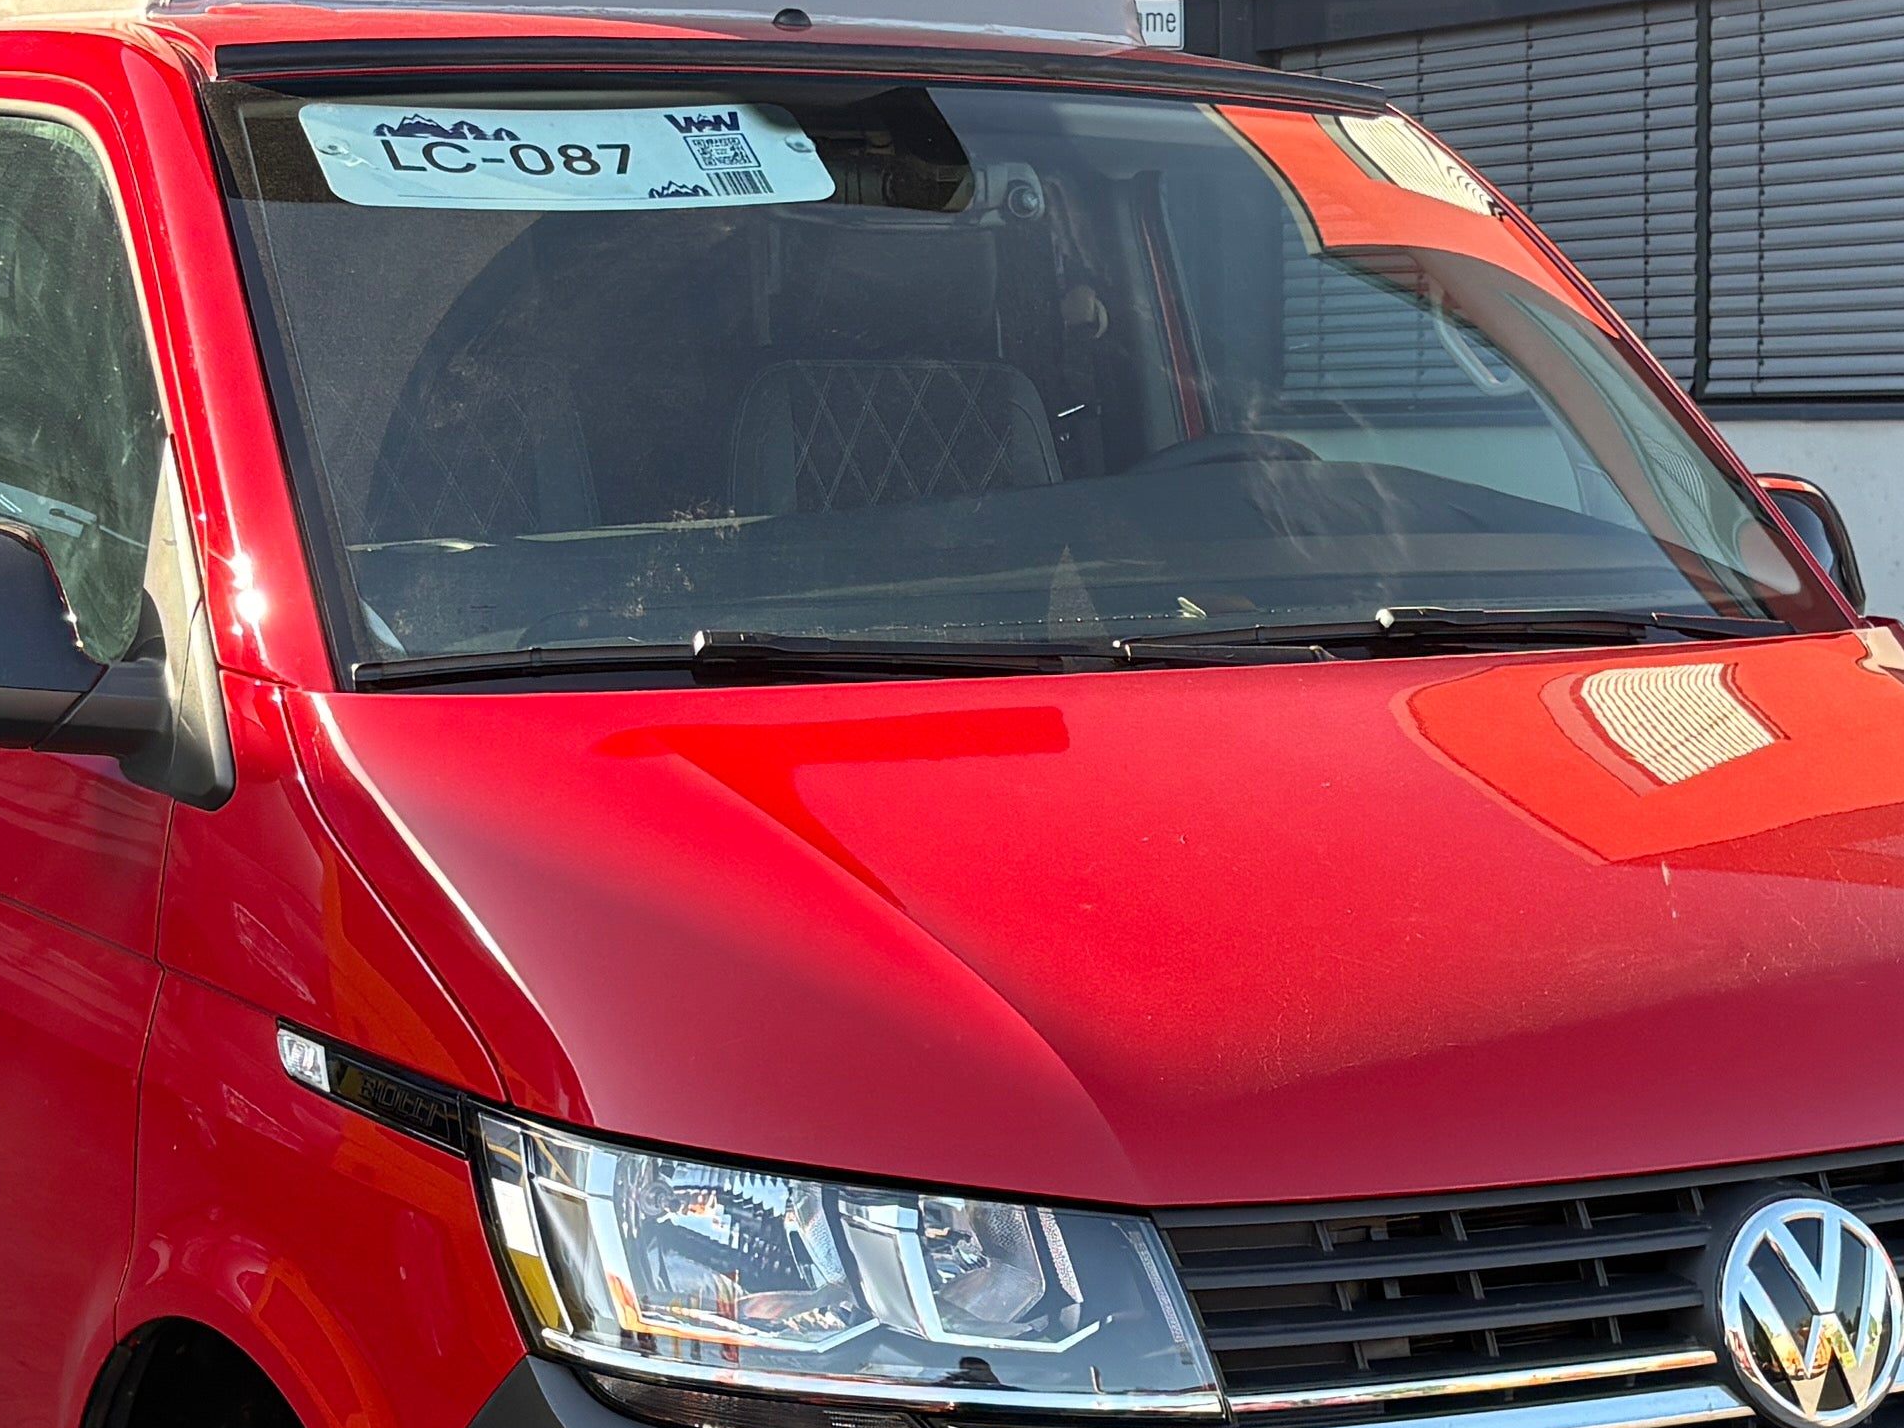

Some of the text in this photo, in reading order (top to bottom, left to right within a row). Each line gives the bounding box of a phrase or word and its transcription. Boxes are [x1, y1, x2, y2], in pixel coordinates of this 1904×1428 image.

[1137, 12, 1176, 33] me
[380, 139, 631, 176] LC-087
[1724, 1202, 1902, 1424] VW
